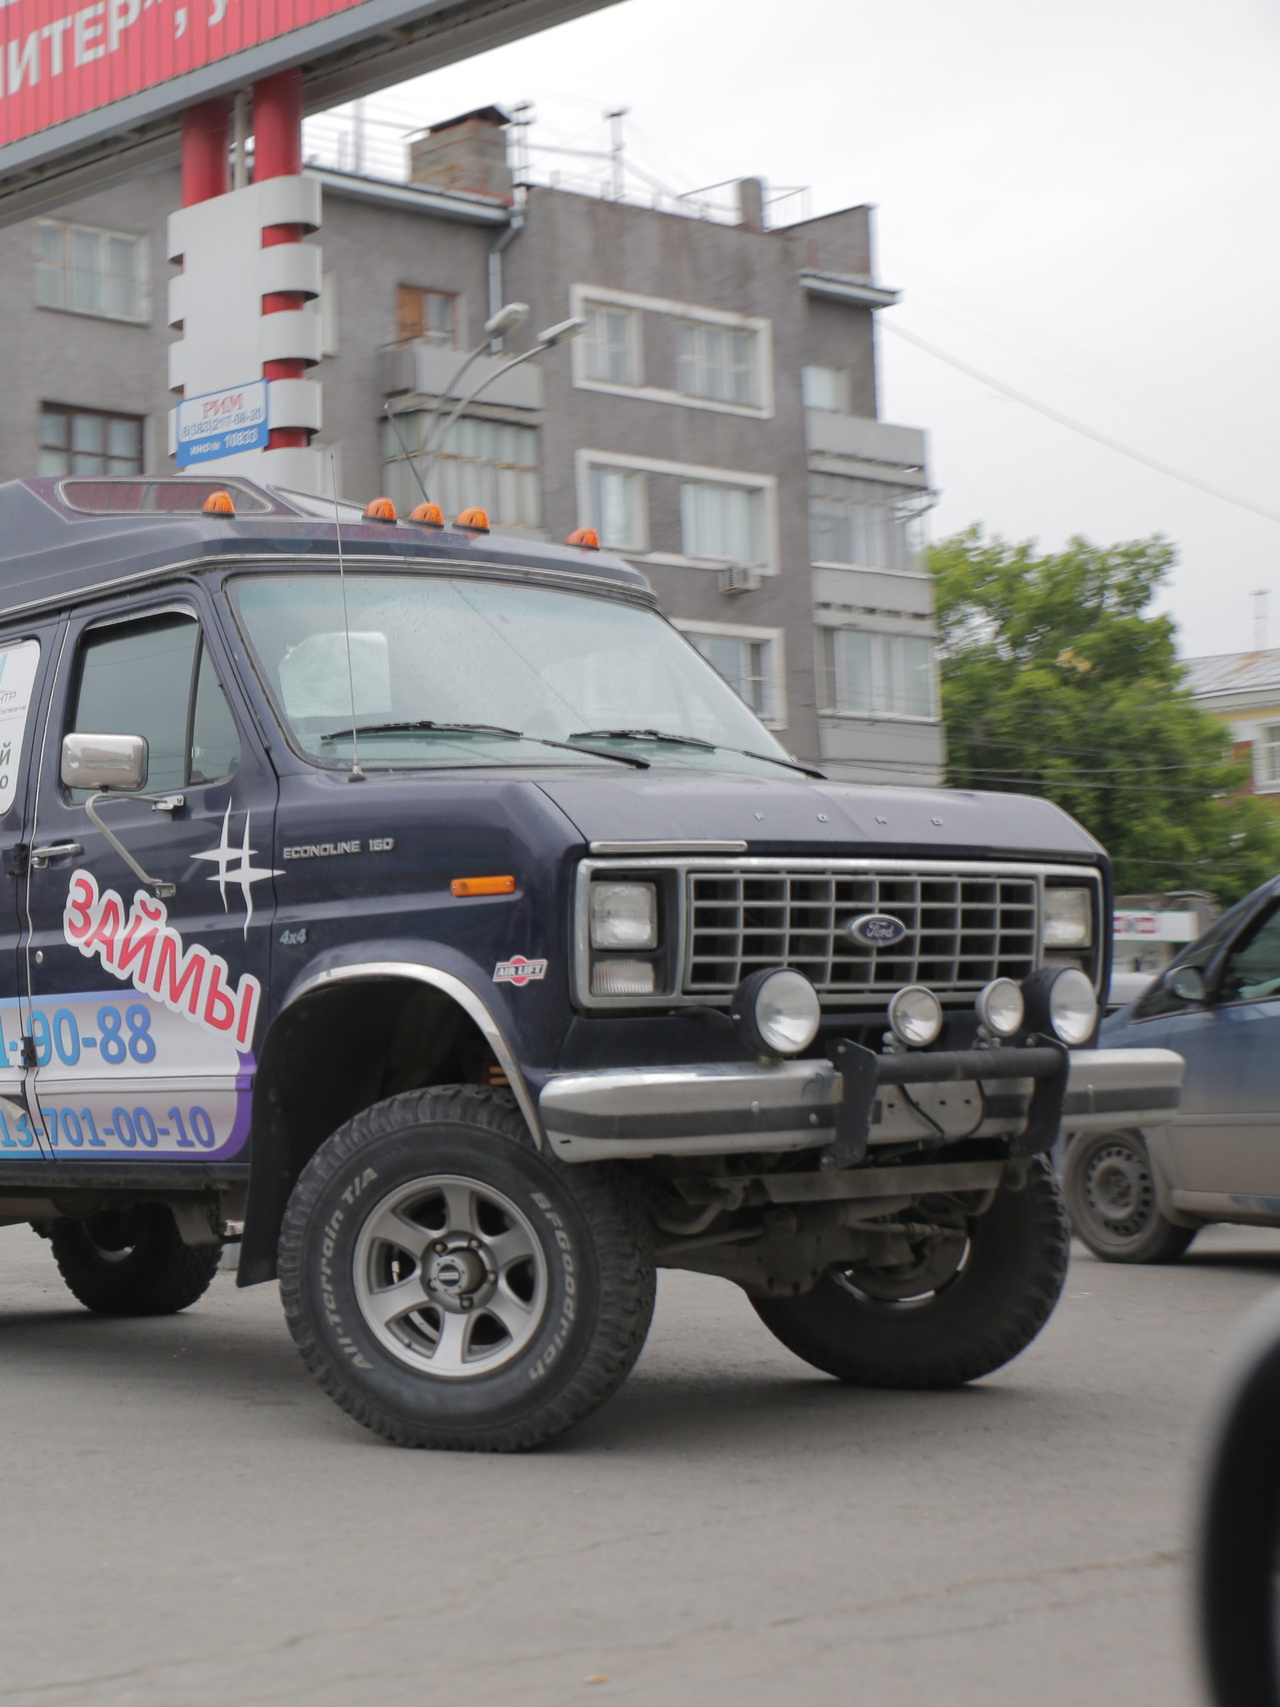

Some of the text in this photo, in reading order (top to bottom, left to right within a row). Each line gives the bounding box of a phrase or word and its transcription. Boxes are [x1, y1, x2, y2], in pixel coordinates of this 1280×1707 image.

[753, 811, 944, 827] FORD
[283, 838, 395, 860] ECONOLINE 150
[279, 928, 307, 945] 4x4
[866, 920, 896, 939] Ford
[67, 876, 256, 1046] ЗАЙМЫ
[496, 964, 543, 977] AIR LIFT
[341, 1166, 379, 1205] T/A
